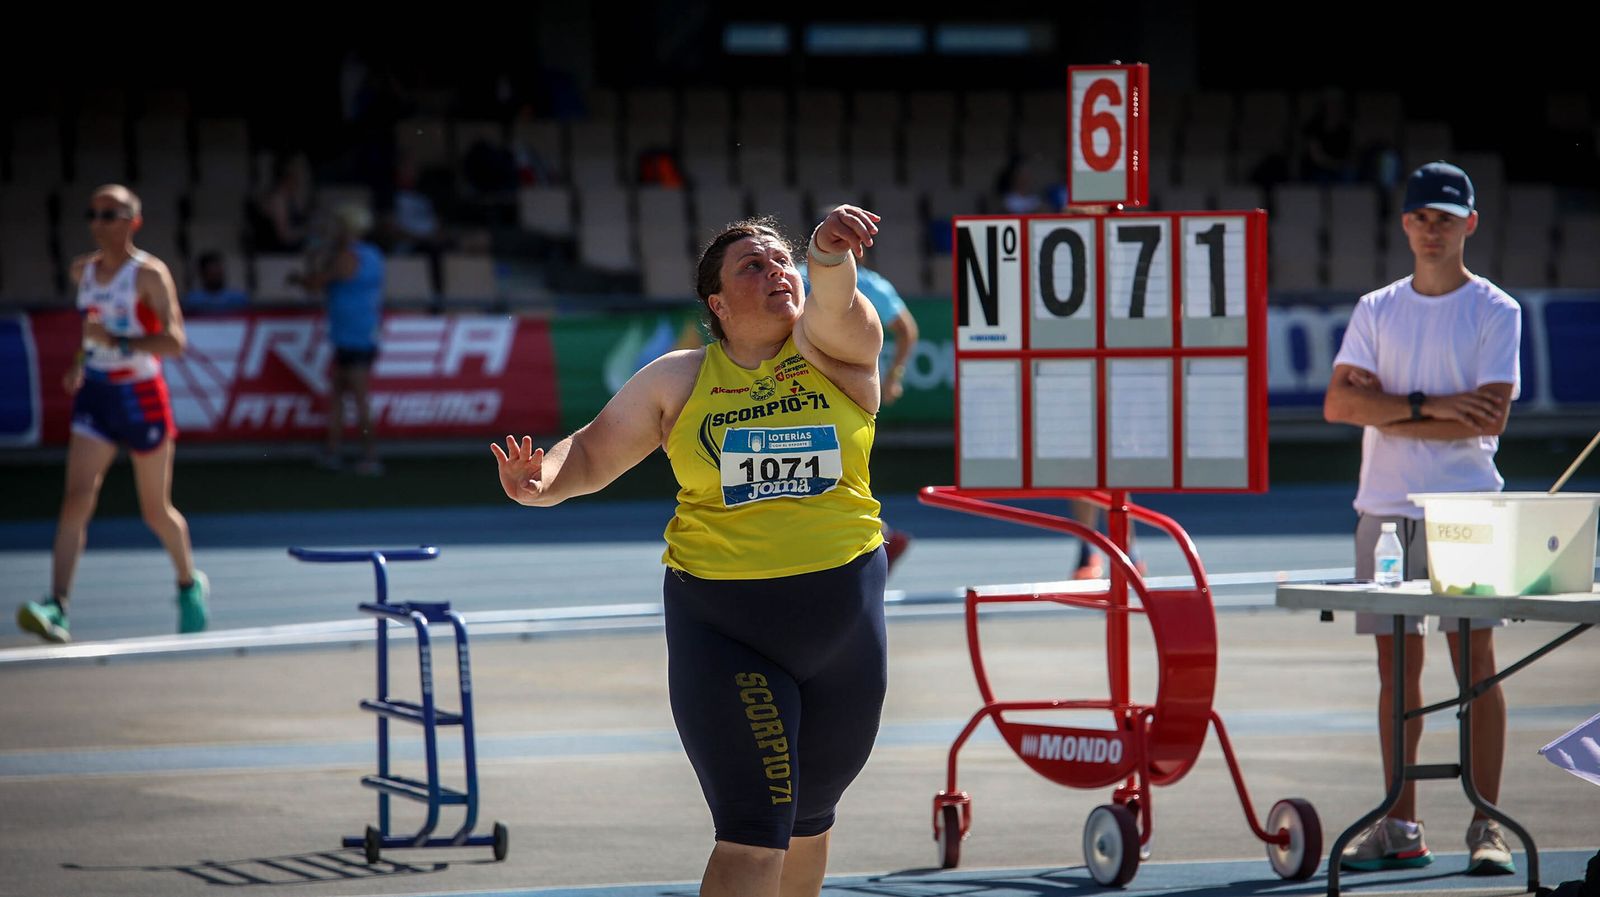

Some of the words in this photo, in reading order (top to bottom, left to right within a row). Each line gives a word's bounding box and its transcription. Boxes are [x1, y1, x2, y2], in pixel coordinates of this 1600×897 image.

[1080, 77, 1122, 172] 6
[244, 316, 518, 394] REA
[711, 386, 750, 395] Alcampo
[712, 394, 830, 427] SCORPIO-71
[768, 430, 812, 441] LOTERÍAS
[739, 455, 820, 482] 1071
[1437, 524, 1473, 540] PESO
[735, 672, 792, 805] SCORPIO71
[1039, 733, 1123, 764] MONDO
